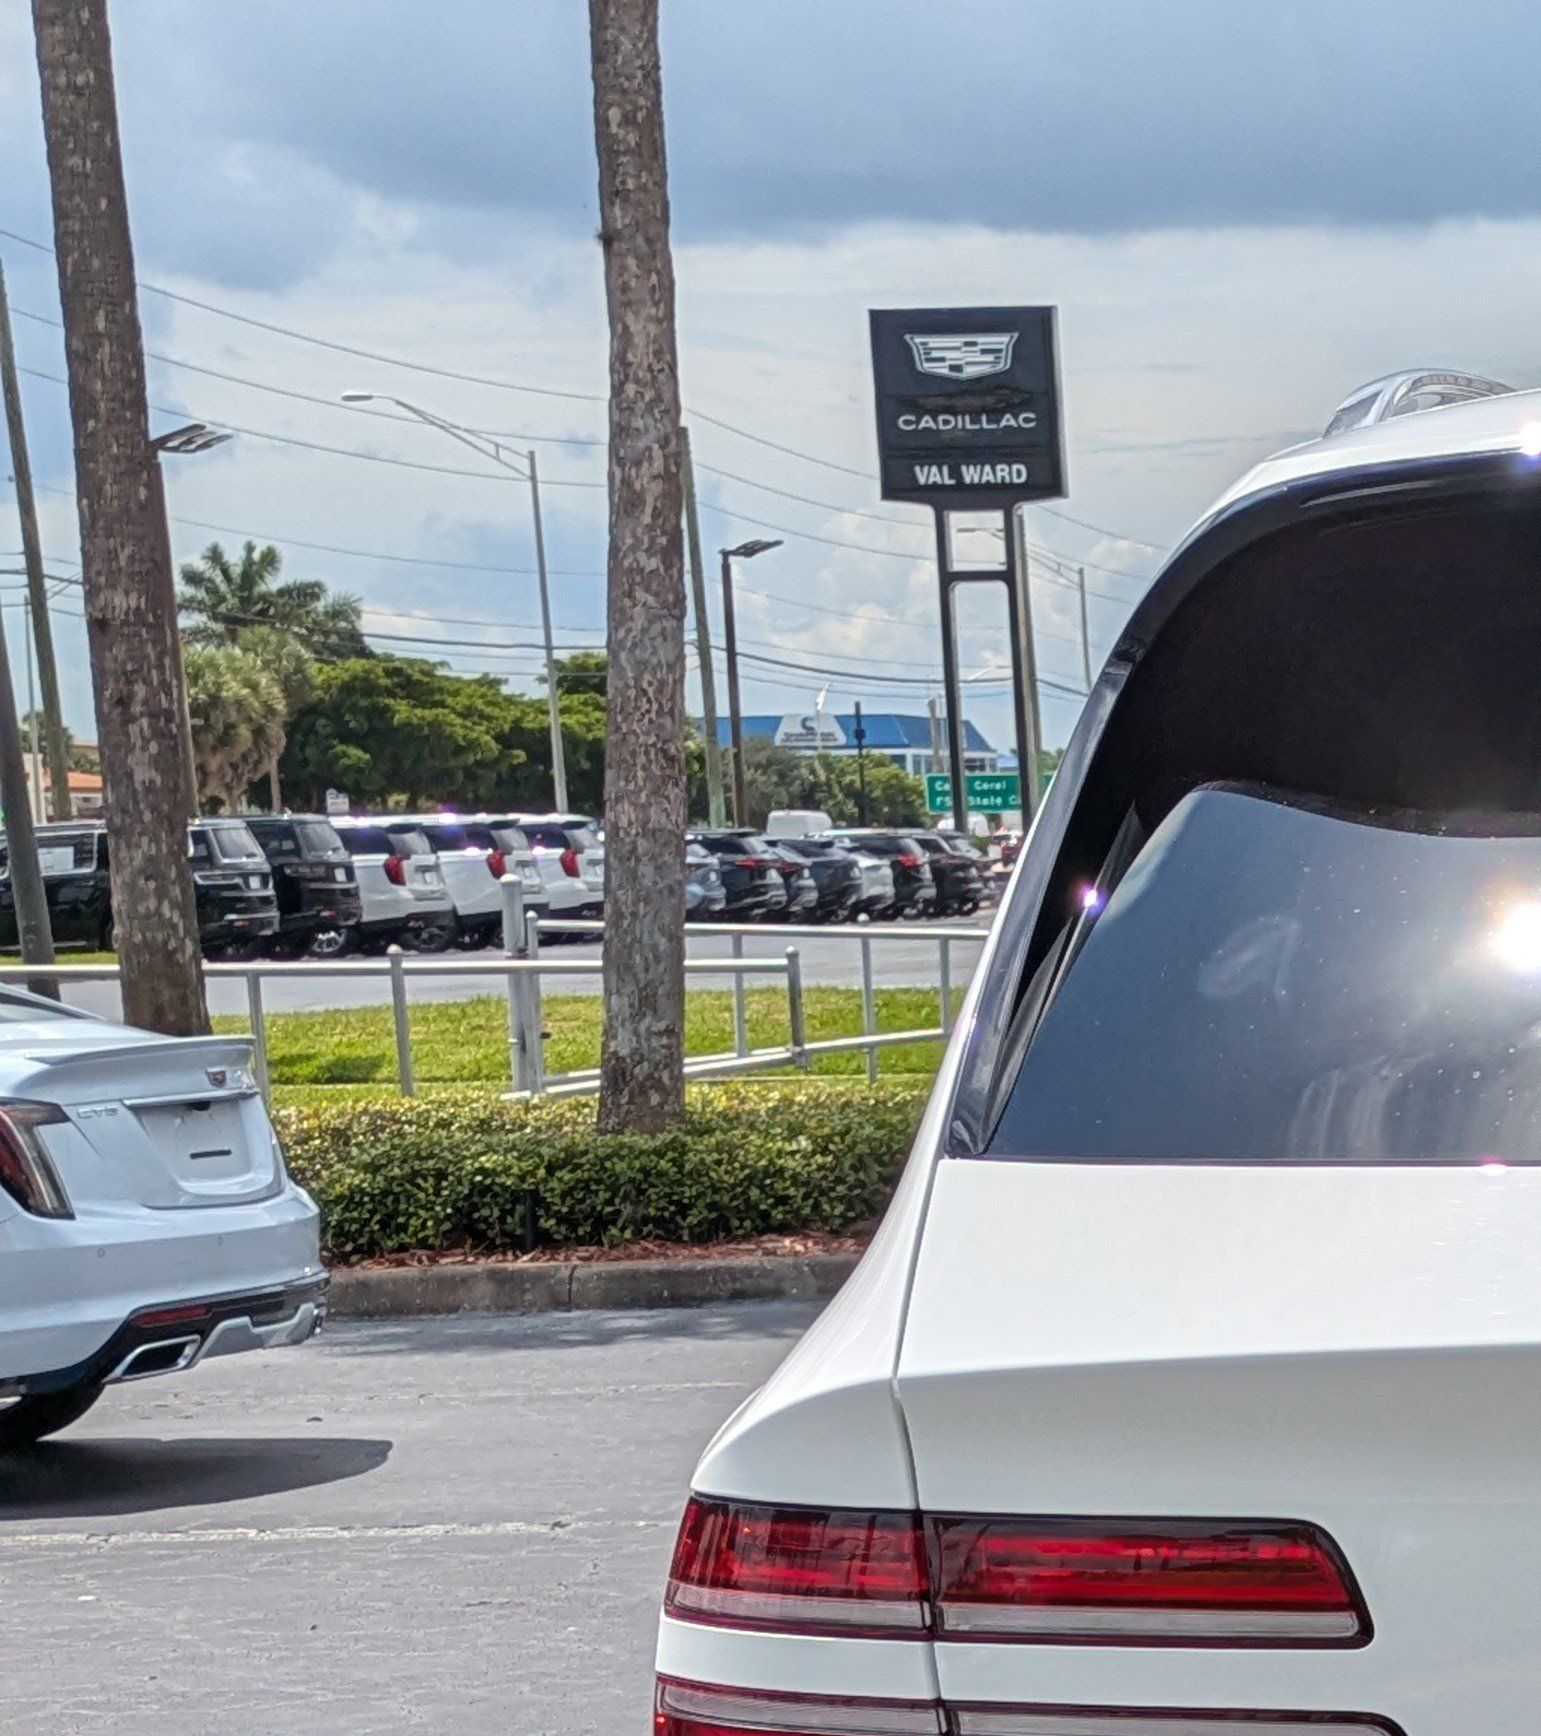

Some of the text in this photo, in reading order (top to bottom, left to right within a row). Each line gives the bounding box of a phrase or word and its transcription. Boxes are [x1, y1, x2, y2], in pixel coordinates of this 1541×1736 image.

[898, 412, 1037, 431] CADILLAC
[914, 463, 1027, 485] VAL WARD
